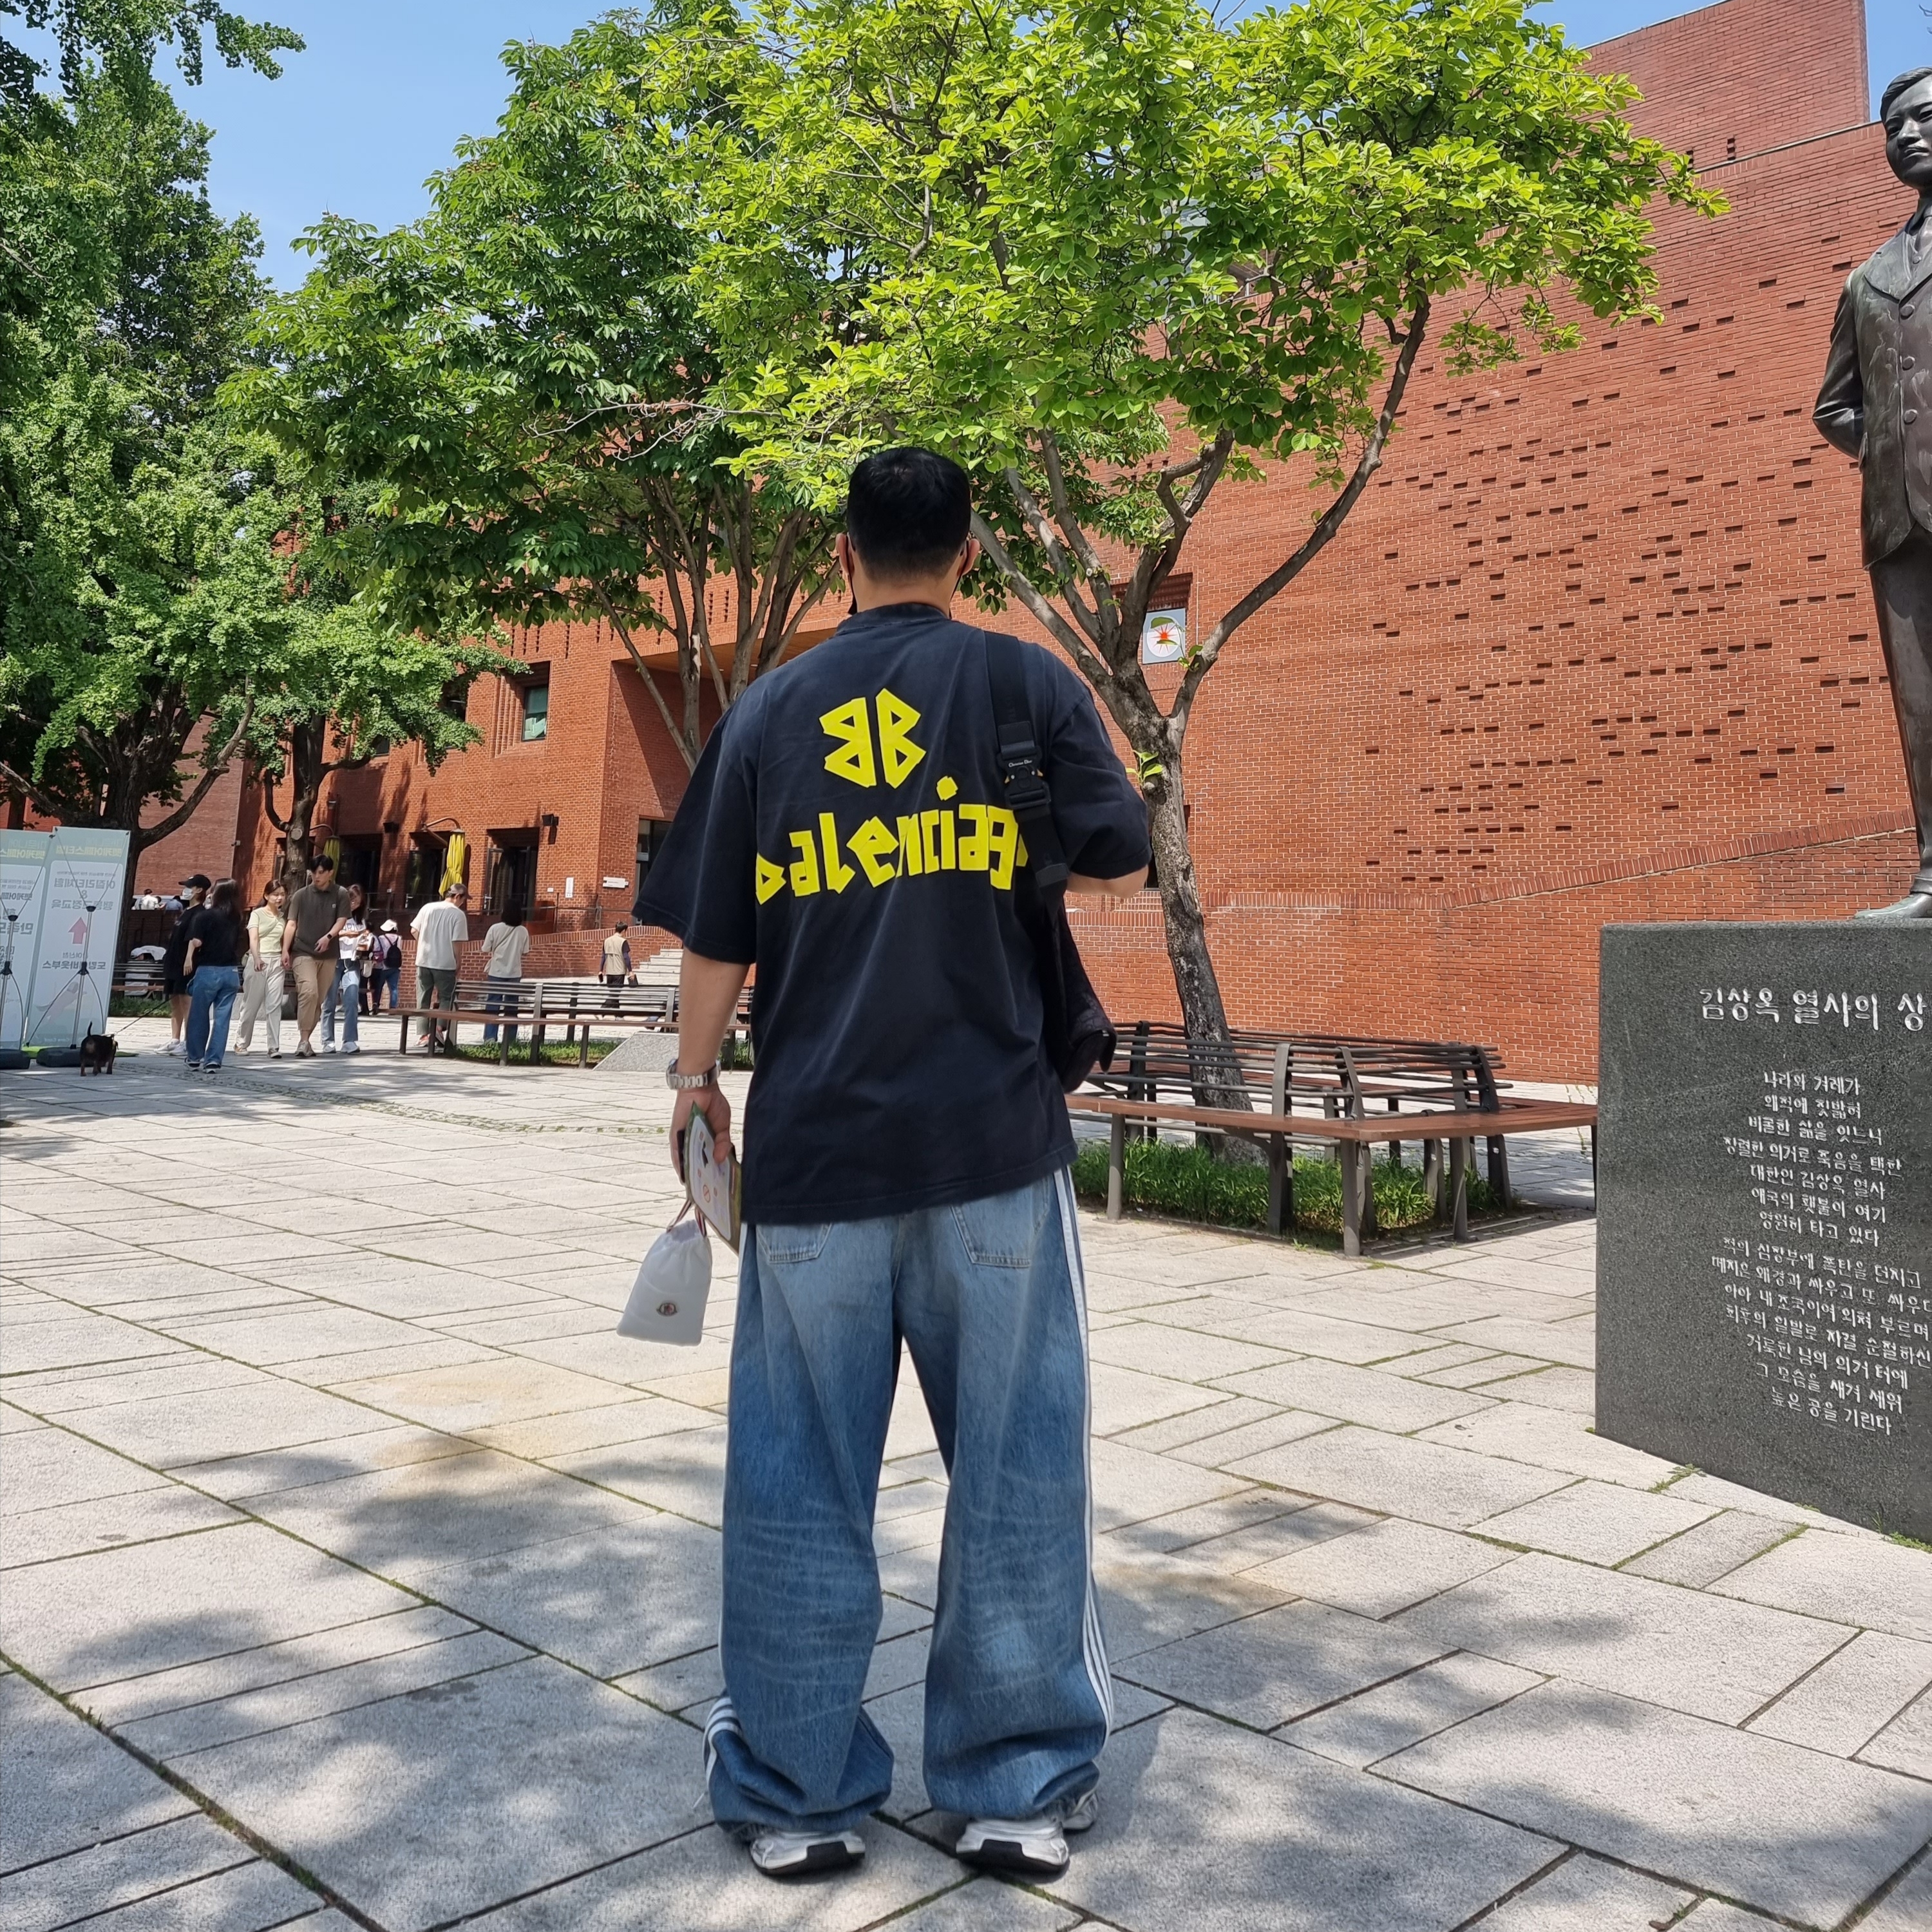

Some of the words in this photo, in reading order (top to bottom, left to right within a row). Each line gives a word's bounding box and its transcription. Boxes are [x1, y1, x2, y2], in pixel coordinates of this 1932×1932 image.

[755, 775, 1028, 905] balenciag
[1700, 987, 1779, 1023] 김상옥
[1792, 989, 1879, 1030] 열사의
[1897, 992, 1927, 1031] 상
[1764, 1071, 1805, 1091] 나라와
[1814, 1075, 1861, 1095] 겨레가
[1765, 1094, 1808, 1114] 왜적에
[1815, 1099, 1861, 1119] 짓밟혀
[1748, 1115, 1790, 1136] 비굴한
[1799, 1120, 1827, 1141] 삶을
[1836, 1125, 1882, 1146] 잇느니
[1723, 1137, 1764, 1159] 장렬한
[1770, 1143, 1811, 1164] 의거로
[1817, 1149, 1862, 1172] 죽음을
[1870, 1157, 1902, 1177] 택한
[1750, 1164, 1794, 1186] 대한인
[1801, 1171, 1845, 1194] 김상옥
[1854, 1179, 1885, 1200] 열사
[1752, 1188, 1794, 1210] 애국의
[1802, 1194, 1845, 1218] 횃불이
[1855, 1204, 1886, 1223] 여기
[1760, 1211, 1801, 1234] 영원히
[1810, 1220, 1838, 1239] 타고
[1849, 1225, 1879, 1247] 있다
[1712, 1255, 1750, 1279] 떼지은
[1756, 1265, 1801, 1291] 왜경과
[1808, 1277, 1853, 1300] 싸우고
[1862, 1287, 1876, 1305] 또
[1723, 1237, 1749, 1257] 적의
[1757, 1243, 1814, 1270] 심장부에
[1823, 1256, 1867, 1280] 폭탄을
[1874, 1264, 1921, 1289] 던지고
[1725, 1283, 1751, 1302] 아아
[1759, 1290, 1772, 1307] 내
[1778, 1294, 1835, 1322] 조국이여
[1842, 1307, 1871, 1329] 외쳐
[1880, 1316, 1929, 1341] 부르며
[1726, 1304, 1765, 1329] 최후의
[1775, 1316, 1817, 1341] 일발로
[1826, 1329, 1857, 1351] 자결
[1866, 1337, 1931, 1369] 순절하신
[1747, 1334, 1791, 1359] 거룩한
[1799, 1347, 1827, 1370] 님의
[1835, 1355, 1868, 1379] 의거
[1875, 1364, 1908, 1390] 터에
[1756, 1362, 1768, 1378] 그
[1777, 1366, 1821, 1392] 모습을
[1830, 1379, 1861, 1403] 새겨
[1869, 1388, 1902, 1414] 세워
[1772, 1387, 1802, 1412] 높은
[1808, 1398, 1837, 1422] 공을
[1844, 1408, 1891, 1435] 기린다
